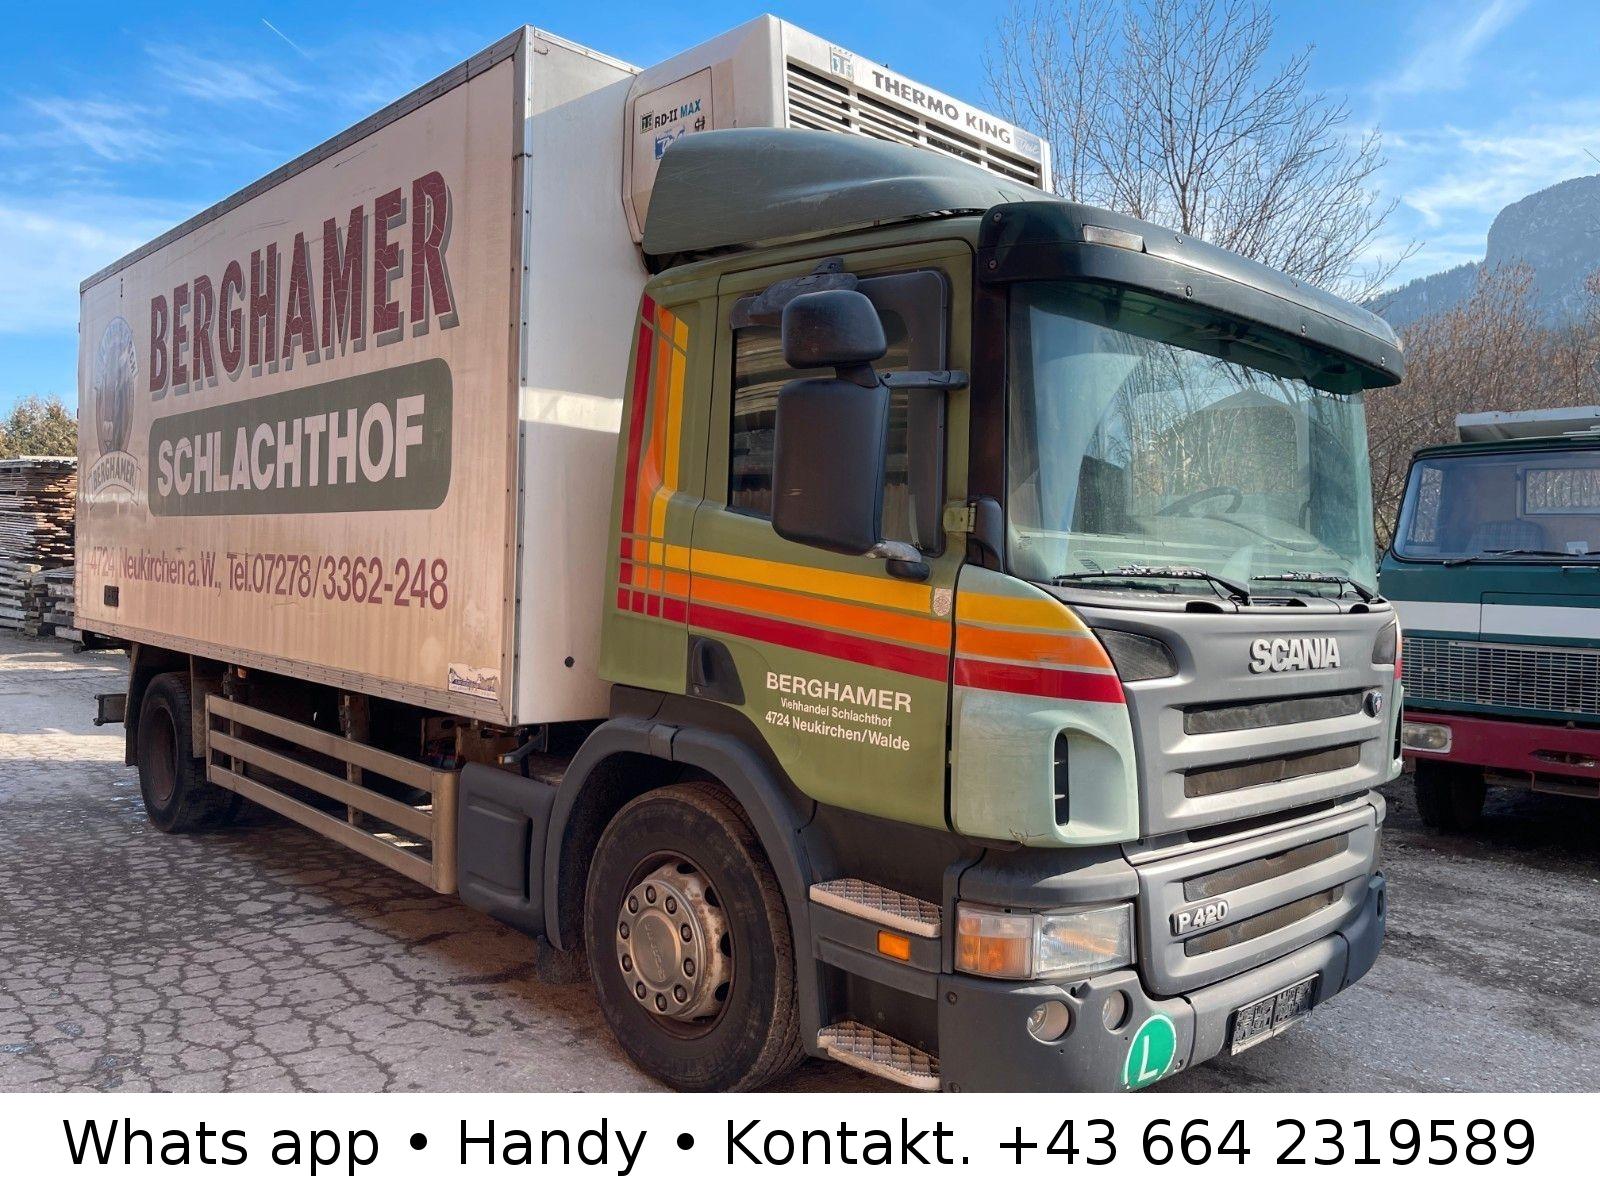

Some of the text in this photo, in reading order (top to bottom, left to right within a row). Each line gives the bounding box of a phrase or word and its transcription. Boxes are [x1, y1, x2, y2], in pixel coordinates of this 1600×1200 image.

[680, 99, 701, 119] MAX
[872, 70, 959, 120] THERMO
[965, 112, 1011, 145] KING
[149, 170, 458, 400] BERGHAMER
[157, 394, 425, 497] SCHLACHTHOF
[119, 548, 185, 586] Neukirchen
[1250, 636, 1342, 674] SCANIA
[766, 671, 912, 713] BERGHAMER
[780, 697, 893, 728] Viehhandel Schlachthof
[765, 710, 911, 752] 4724 Neukirchen/Walde
[1138, 1034, 1159, 1082] L
